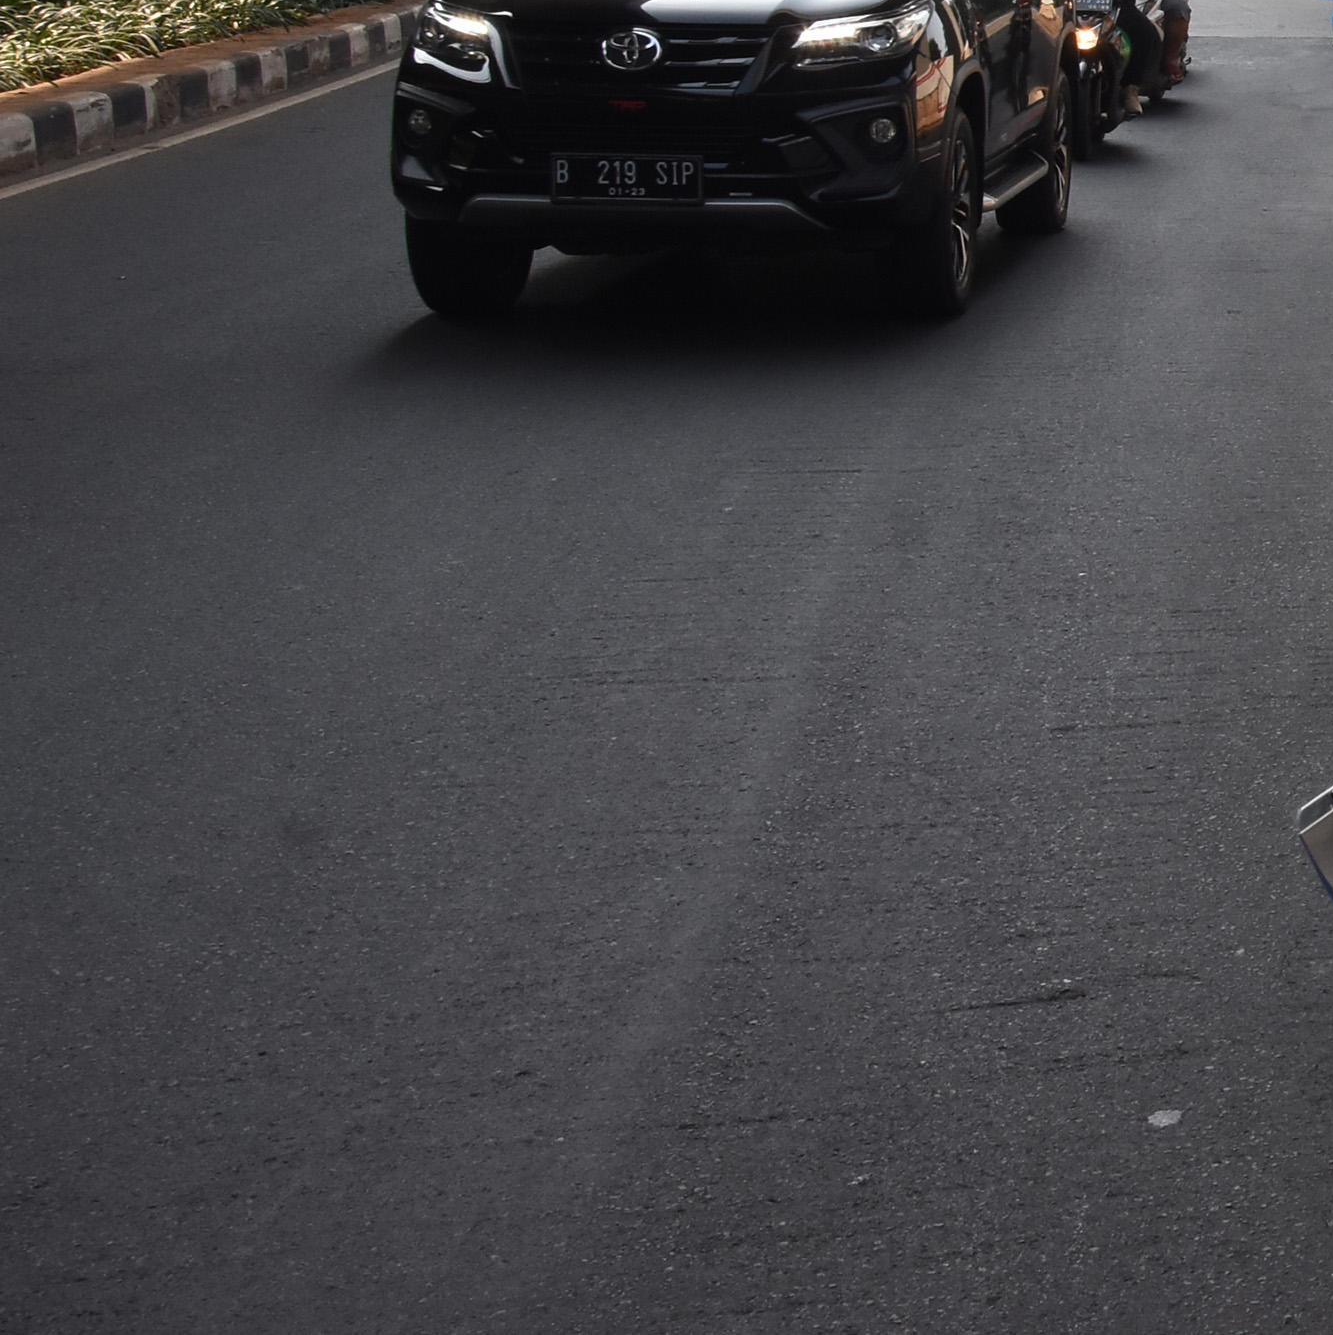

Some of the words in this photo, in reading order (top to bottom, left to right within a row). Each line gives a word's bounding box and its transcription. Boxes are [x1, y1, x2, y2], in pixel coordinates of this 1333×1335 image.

[556, 159, 570, 184] B
[597, 160, 637, 185] 219
[655, 161, 695, 186] SIP
